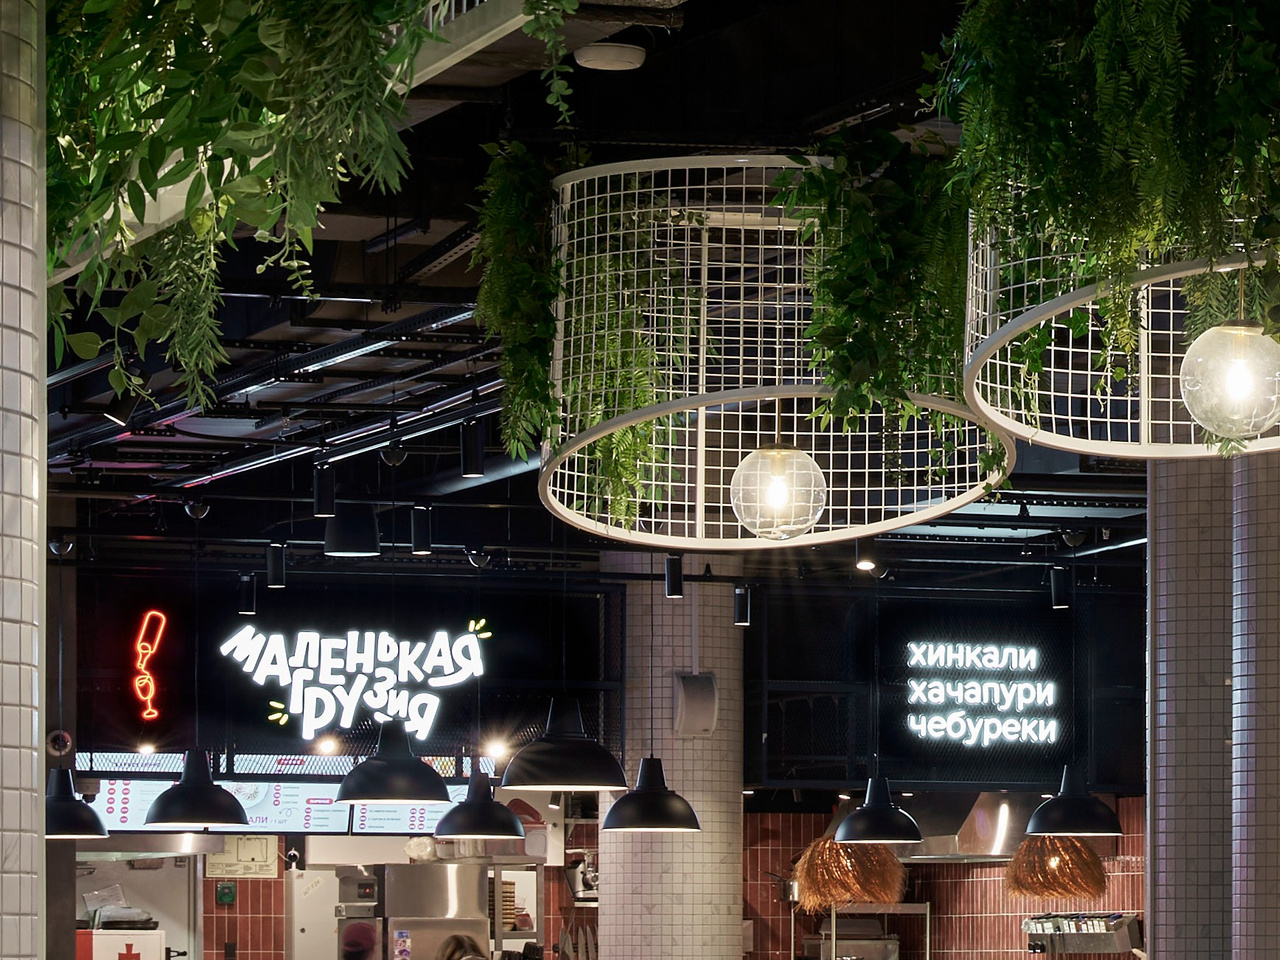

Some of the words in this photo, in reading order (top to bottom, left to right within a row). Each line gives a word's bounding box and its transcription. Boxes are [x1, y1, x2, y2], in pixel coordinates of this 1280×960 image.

[219, 624, 484, 687] МАЛЕНЬКАЯ
[907, 641, 1038, 671] хинкали
[289, 667, 440, 740] ГРУЗИЯ
[907, 677, 1055, 712] хачапури
[907, 709, 1057, 748] чебуреки
